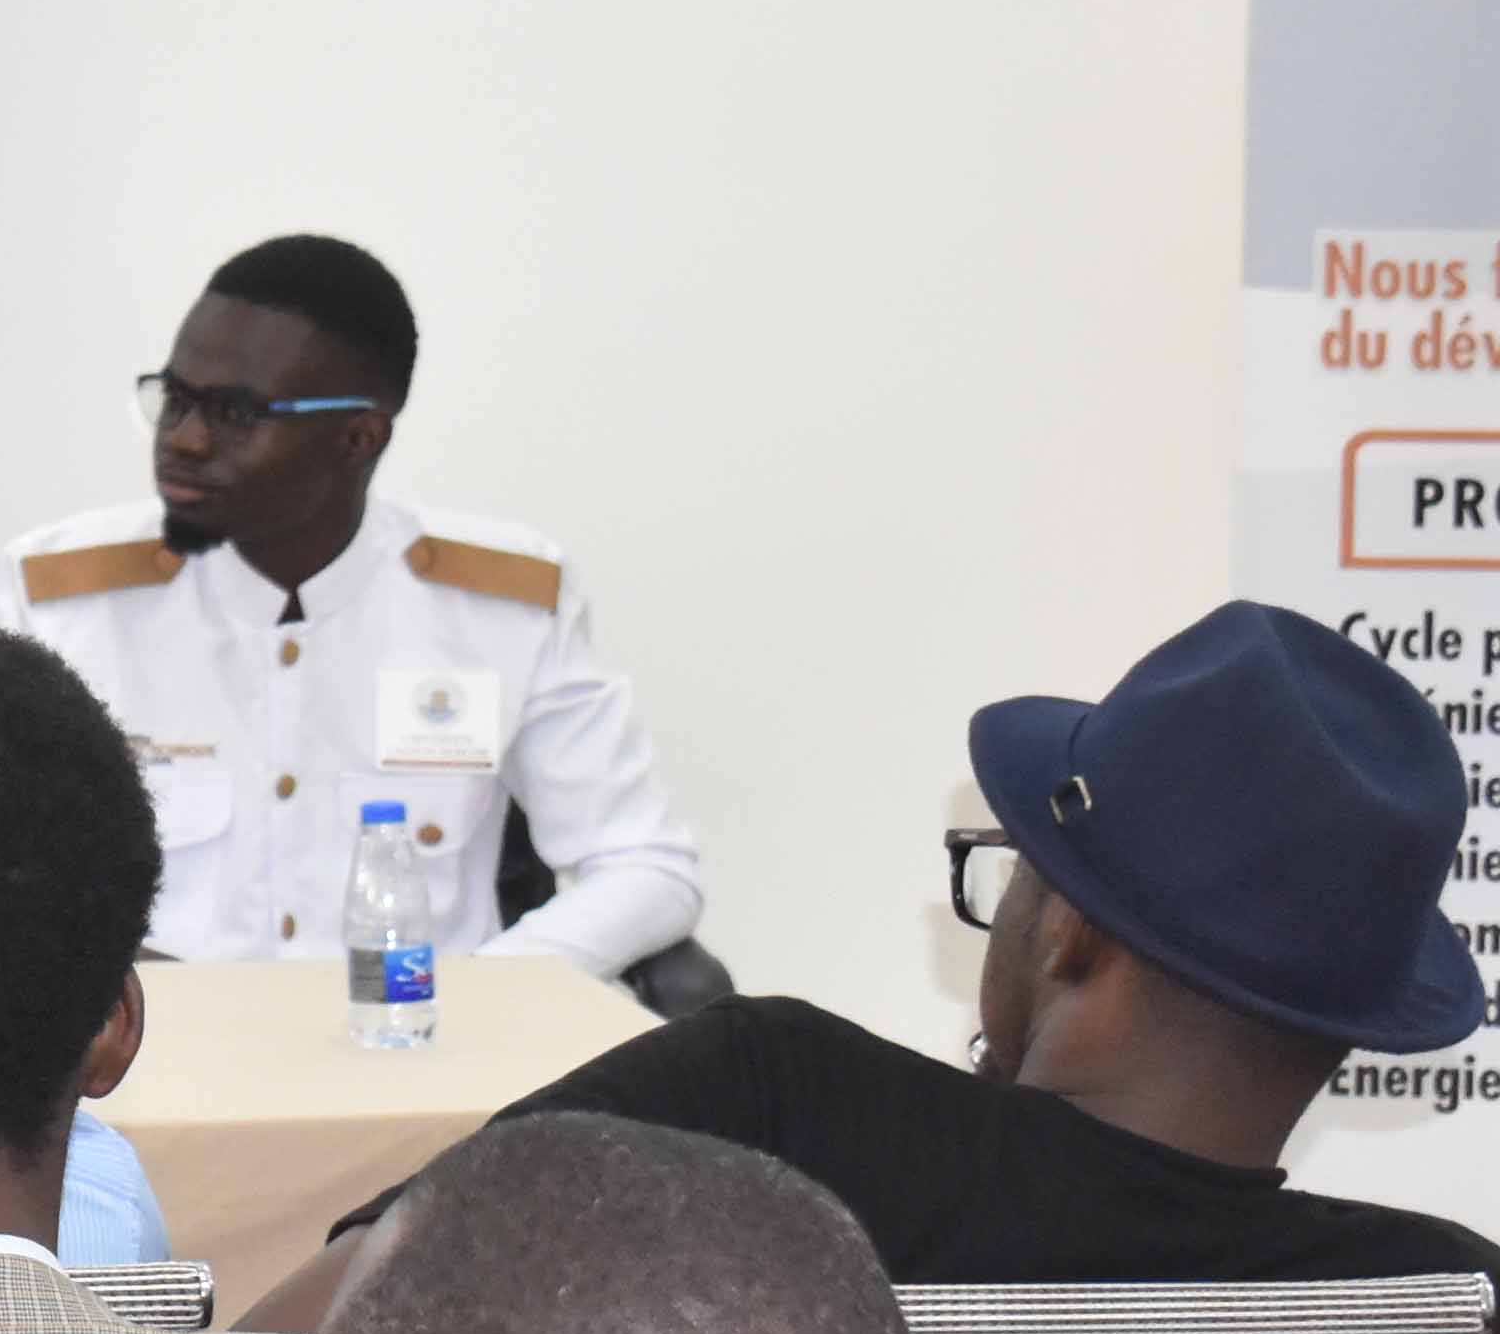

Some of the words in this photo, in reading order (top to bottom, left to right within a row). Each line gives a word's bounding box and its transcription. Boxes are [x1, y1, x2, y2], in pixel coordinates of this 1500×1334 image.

[1322, 240, 1468, 300] Nous
[1320, 308, 1388, 370] du
[1411, 478, 1500, 529] PR
